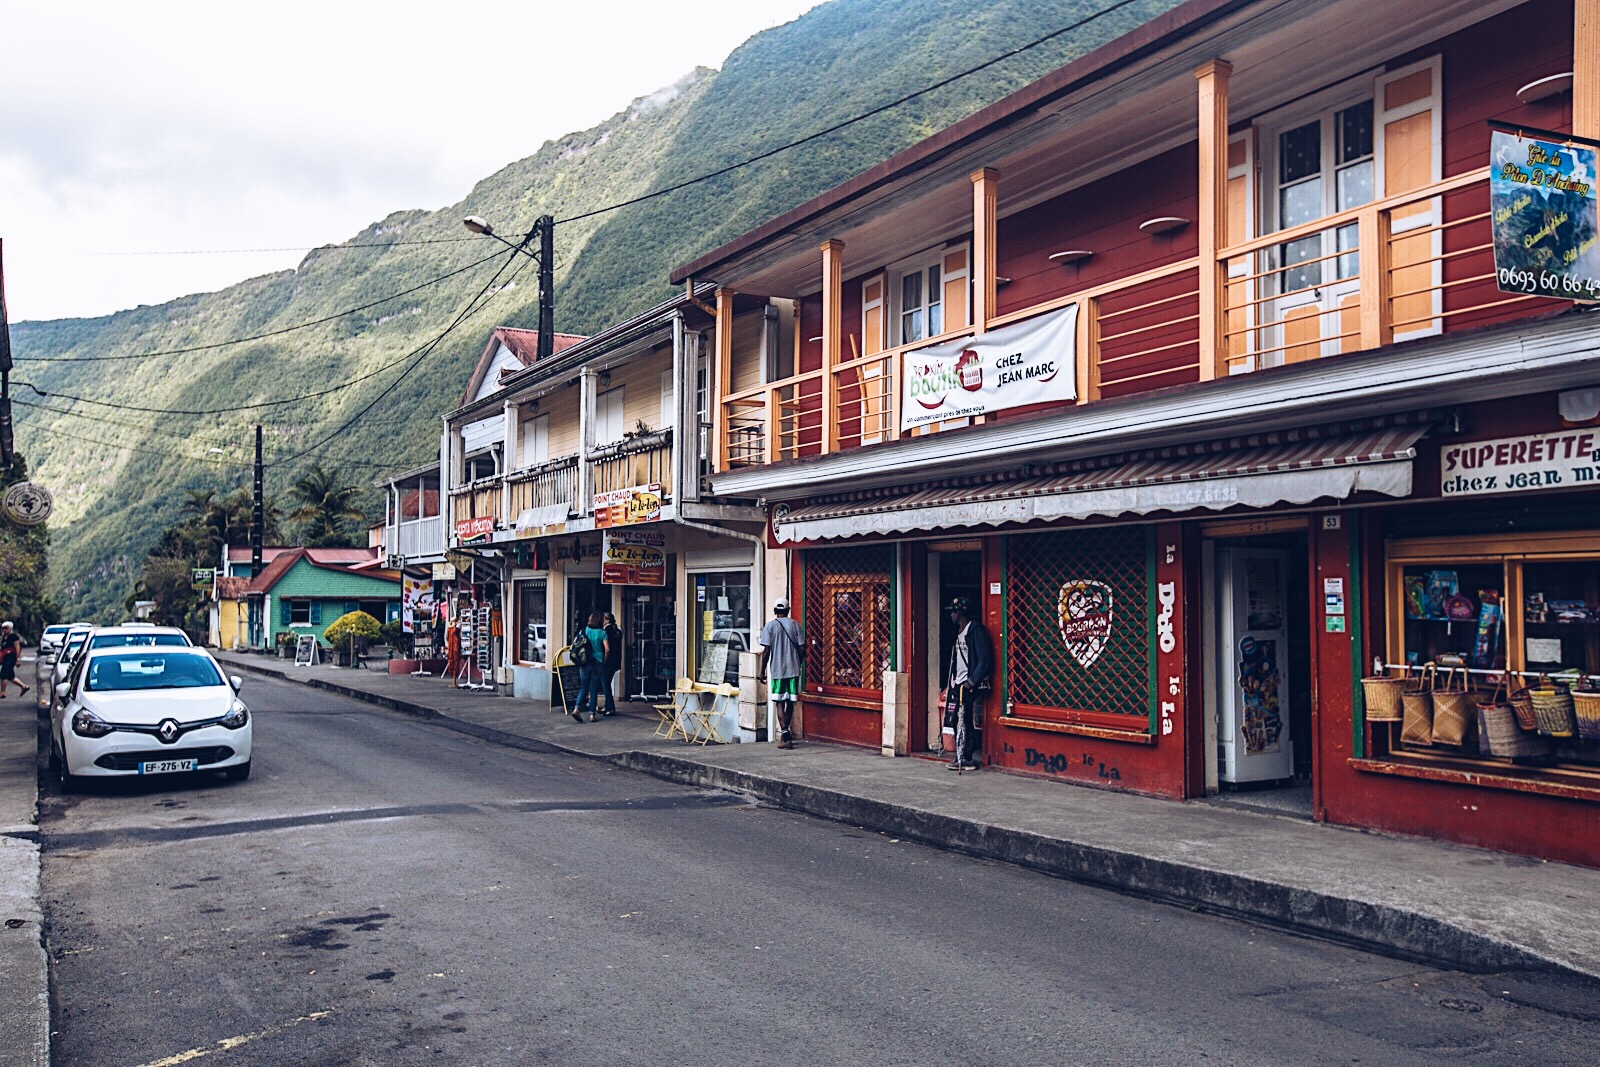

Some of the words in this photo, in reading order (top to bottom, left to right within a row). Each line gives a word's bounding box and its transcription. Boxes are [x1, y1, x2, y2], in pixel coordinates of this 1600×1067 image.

[1500, 163, 1528, 183] Piton
[1499, 265, 1537, 292] 0693
[1540, 269, 1559, 290] 60
[1562, 272, 1582, 293] 66
[996, 352, 1024, 369] CHEZ
[997, 369, 1023, 388] JEAN
[1025, 361, 1055, 379] MARC
[1445, 433, 1594, 472] SUPERETTE
[1443, 475, 1498, 494] chez
[595, 494, 610, 506] POINT
[611, 490, 631, 502] CHAUD
[630, 501, 637, 512] Le
[1326, 517, 1337, 527] 53
[605, 530, 632, 539] POINT
[634, 532, 665, 541] CHAUD
[612, 548, 624, 558] Le
[1161, 701, 1175, 736] La
